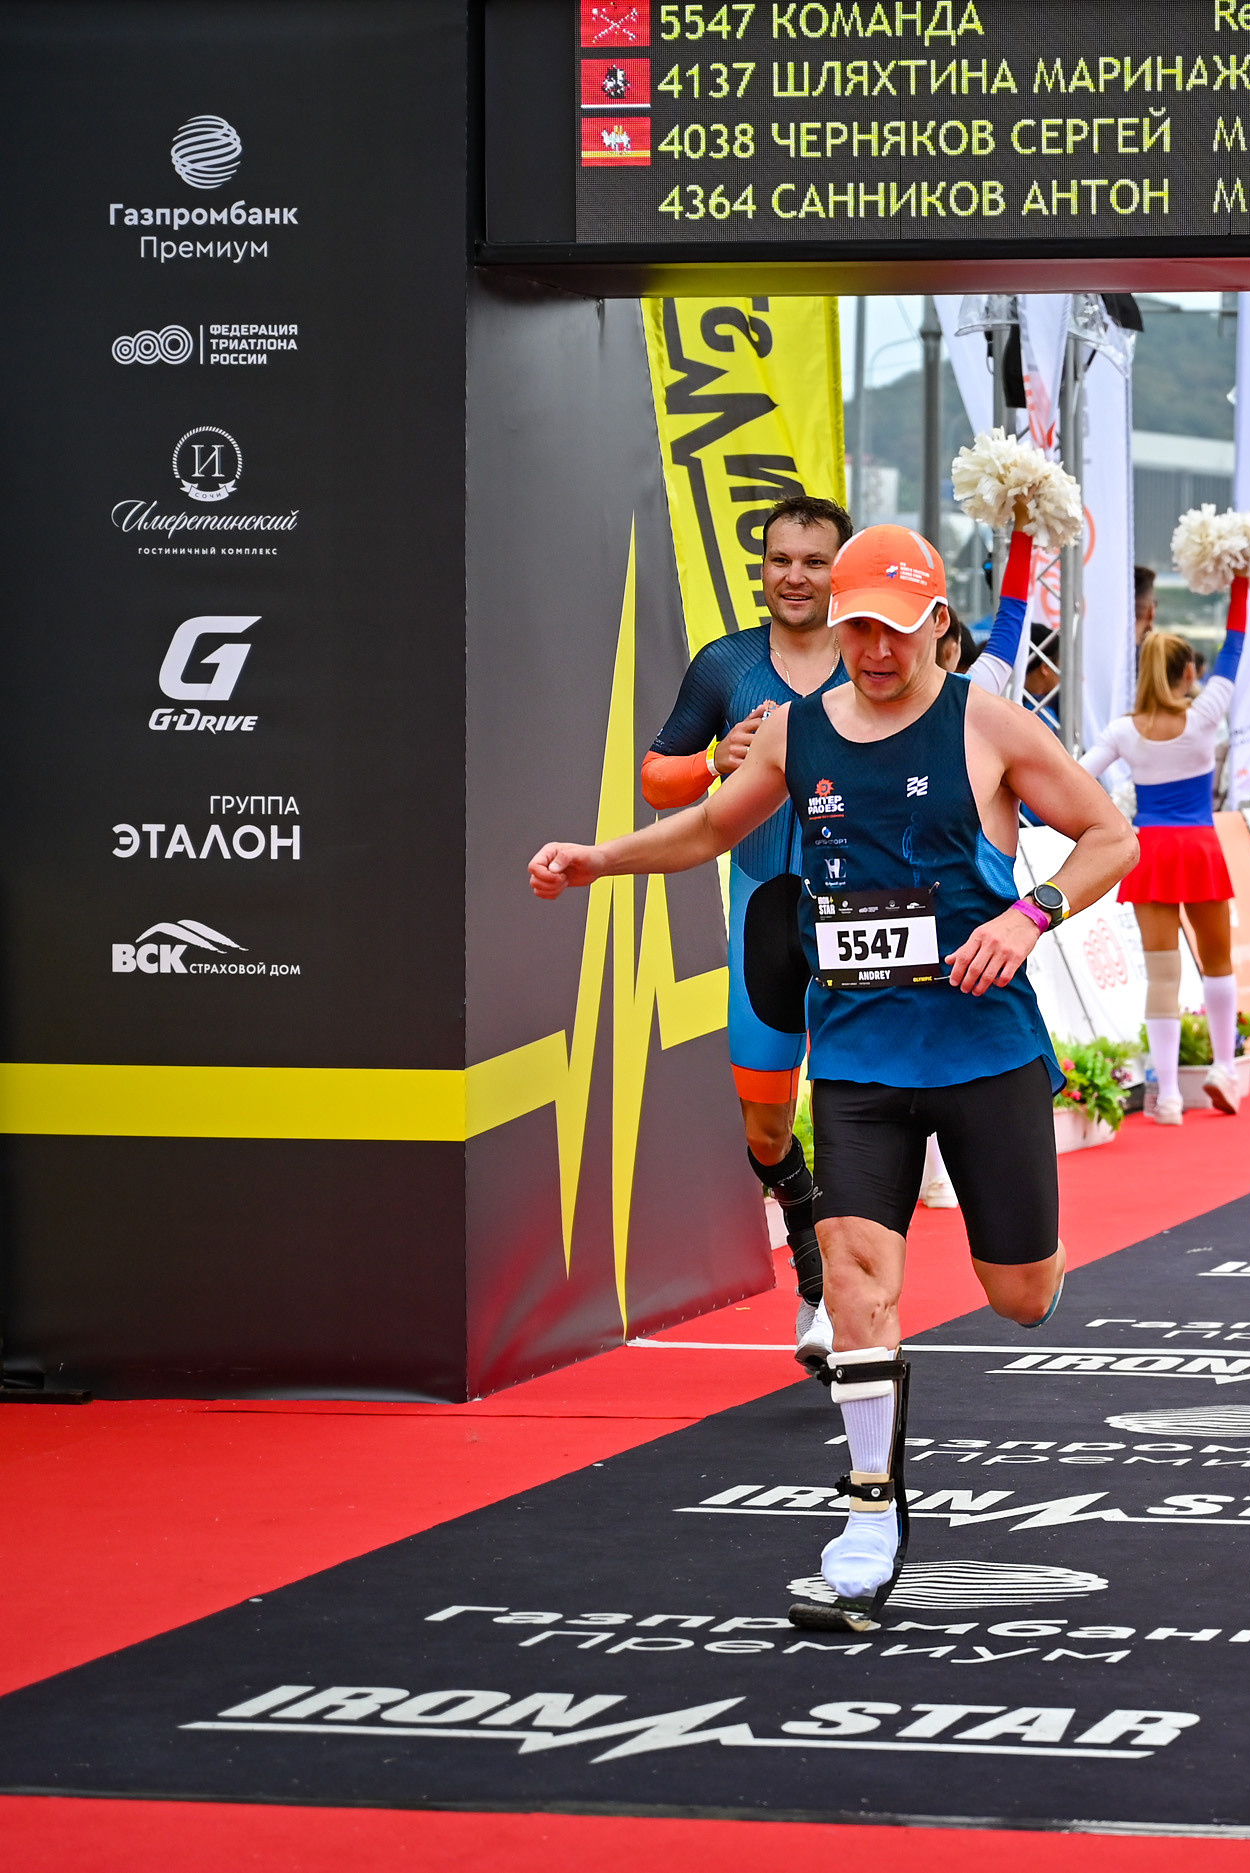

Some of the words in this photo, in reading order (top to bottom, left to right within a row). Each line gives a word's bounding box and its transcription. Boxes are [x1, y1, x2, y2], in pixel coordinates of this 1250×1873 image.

[659, 4, 752, 40] 5547
[771, 0, 985, 46] КОМАНДА
[658, 64, 756, 98] 4137
[771, 57, 1018, 97] ШЛЯХТИНА
[658, 124, 755, 160] 4038
[771, 118, 995, 158] ЧЕРНЯКОВ
[1011, 106, 1172, 154] СЕРГЕЙ
[1213, 115, 1248, 152] М
[109, 200, 299, 231] Газпромбанк
[658, 184, 757, 220] 4364
[771, 179, 1005, 219] САННИКОВ
[1021, 177, 1170, 214] АНТОН
[1213, 177, 1248, 213] М
[140, 236, 268, 263] Премиум
[209, 323, 299, 338] ФЕДЕРАЦИЯ
[209, 339, 299, 351] ТРИАТЛОНА
[209, 353, 268, 366] РОССИИ
[194, 491, 223, 500] СОЧИ
[111, 499, 299, 539] Имеретинский
[138, 545, 217, 556] ГОСТИНИЧНЫЙ
[221, 546, 278, 557] КОМПЛЕКС
[209, 795, 300, 815] ГРУППА
[112, 823, 300, 860] ЭТАЛОН
[112, 943, 188, 974] ВСК
[189, 962, 267, 976] СТРАХОВОЙ
[270, 964, 301, 977] ДОМ
[837, 927, 909, 961] 5547
[858, 970, 891, 981] ANDREY
[519, 1630, 1133, 1664] Премиум
[216, 1684, 628, 1728] IRON
[780, 1700, 1201, 1746] STAR
